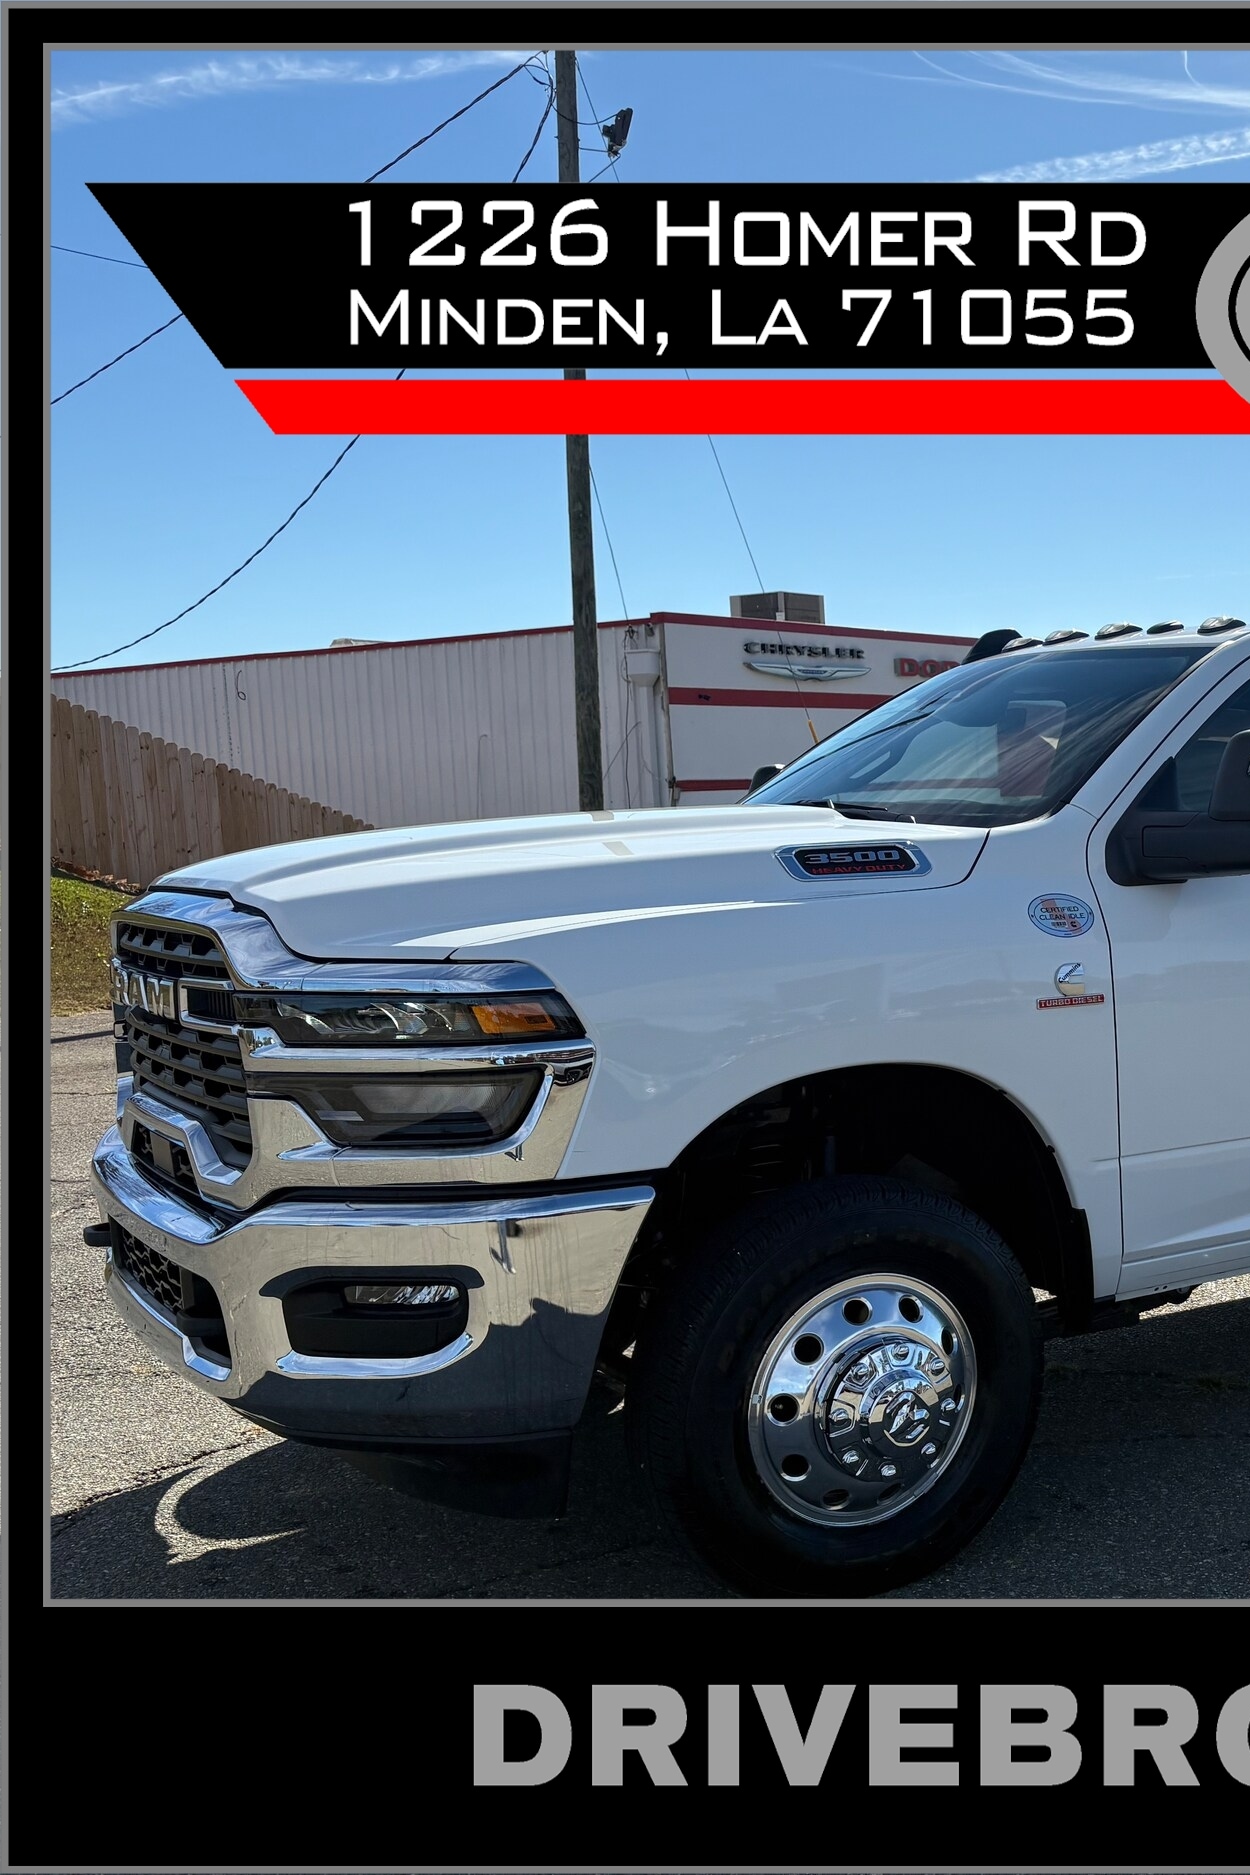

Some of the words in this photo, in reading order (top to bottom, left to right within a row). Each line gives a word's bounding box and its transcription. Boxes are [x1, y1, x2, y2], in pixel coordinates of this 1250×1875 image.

[744, 642, 865, 659] CHRYSLER
[805, 850, 900, 864] 3500
[812, 866, 862, 875] HEAVY
[865, 864, 906, 872] DUTY
[1040, 906, 1079, 914] CERTIFIED
[111, 968, 175, 1020] RAM
[1040, 998, 1070, 1007] TURBO
[1072, 995, 1103, 1004] DIESEL
